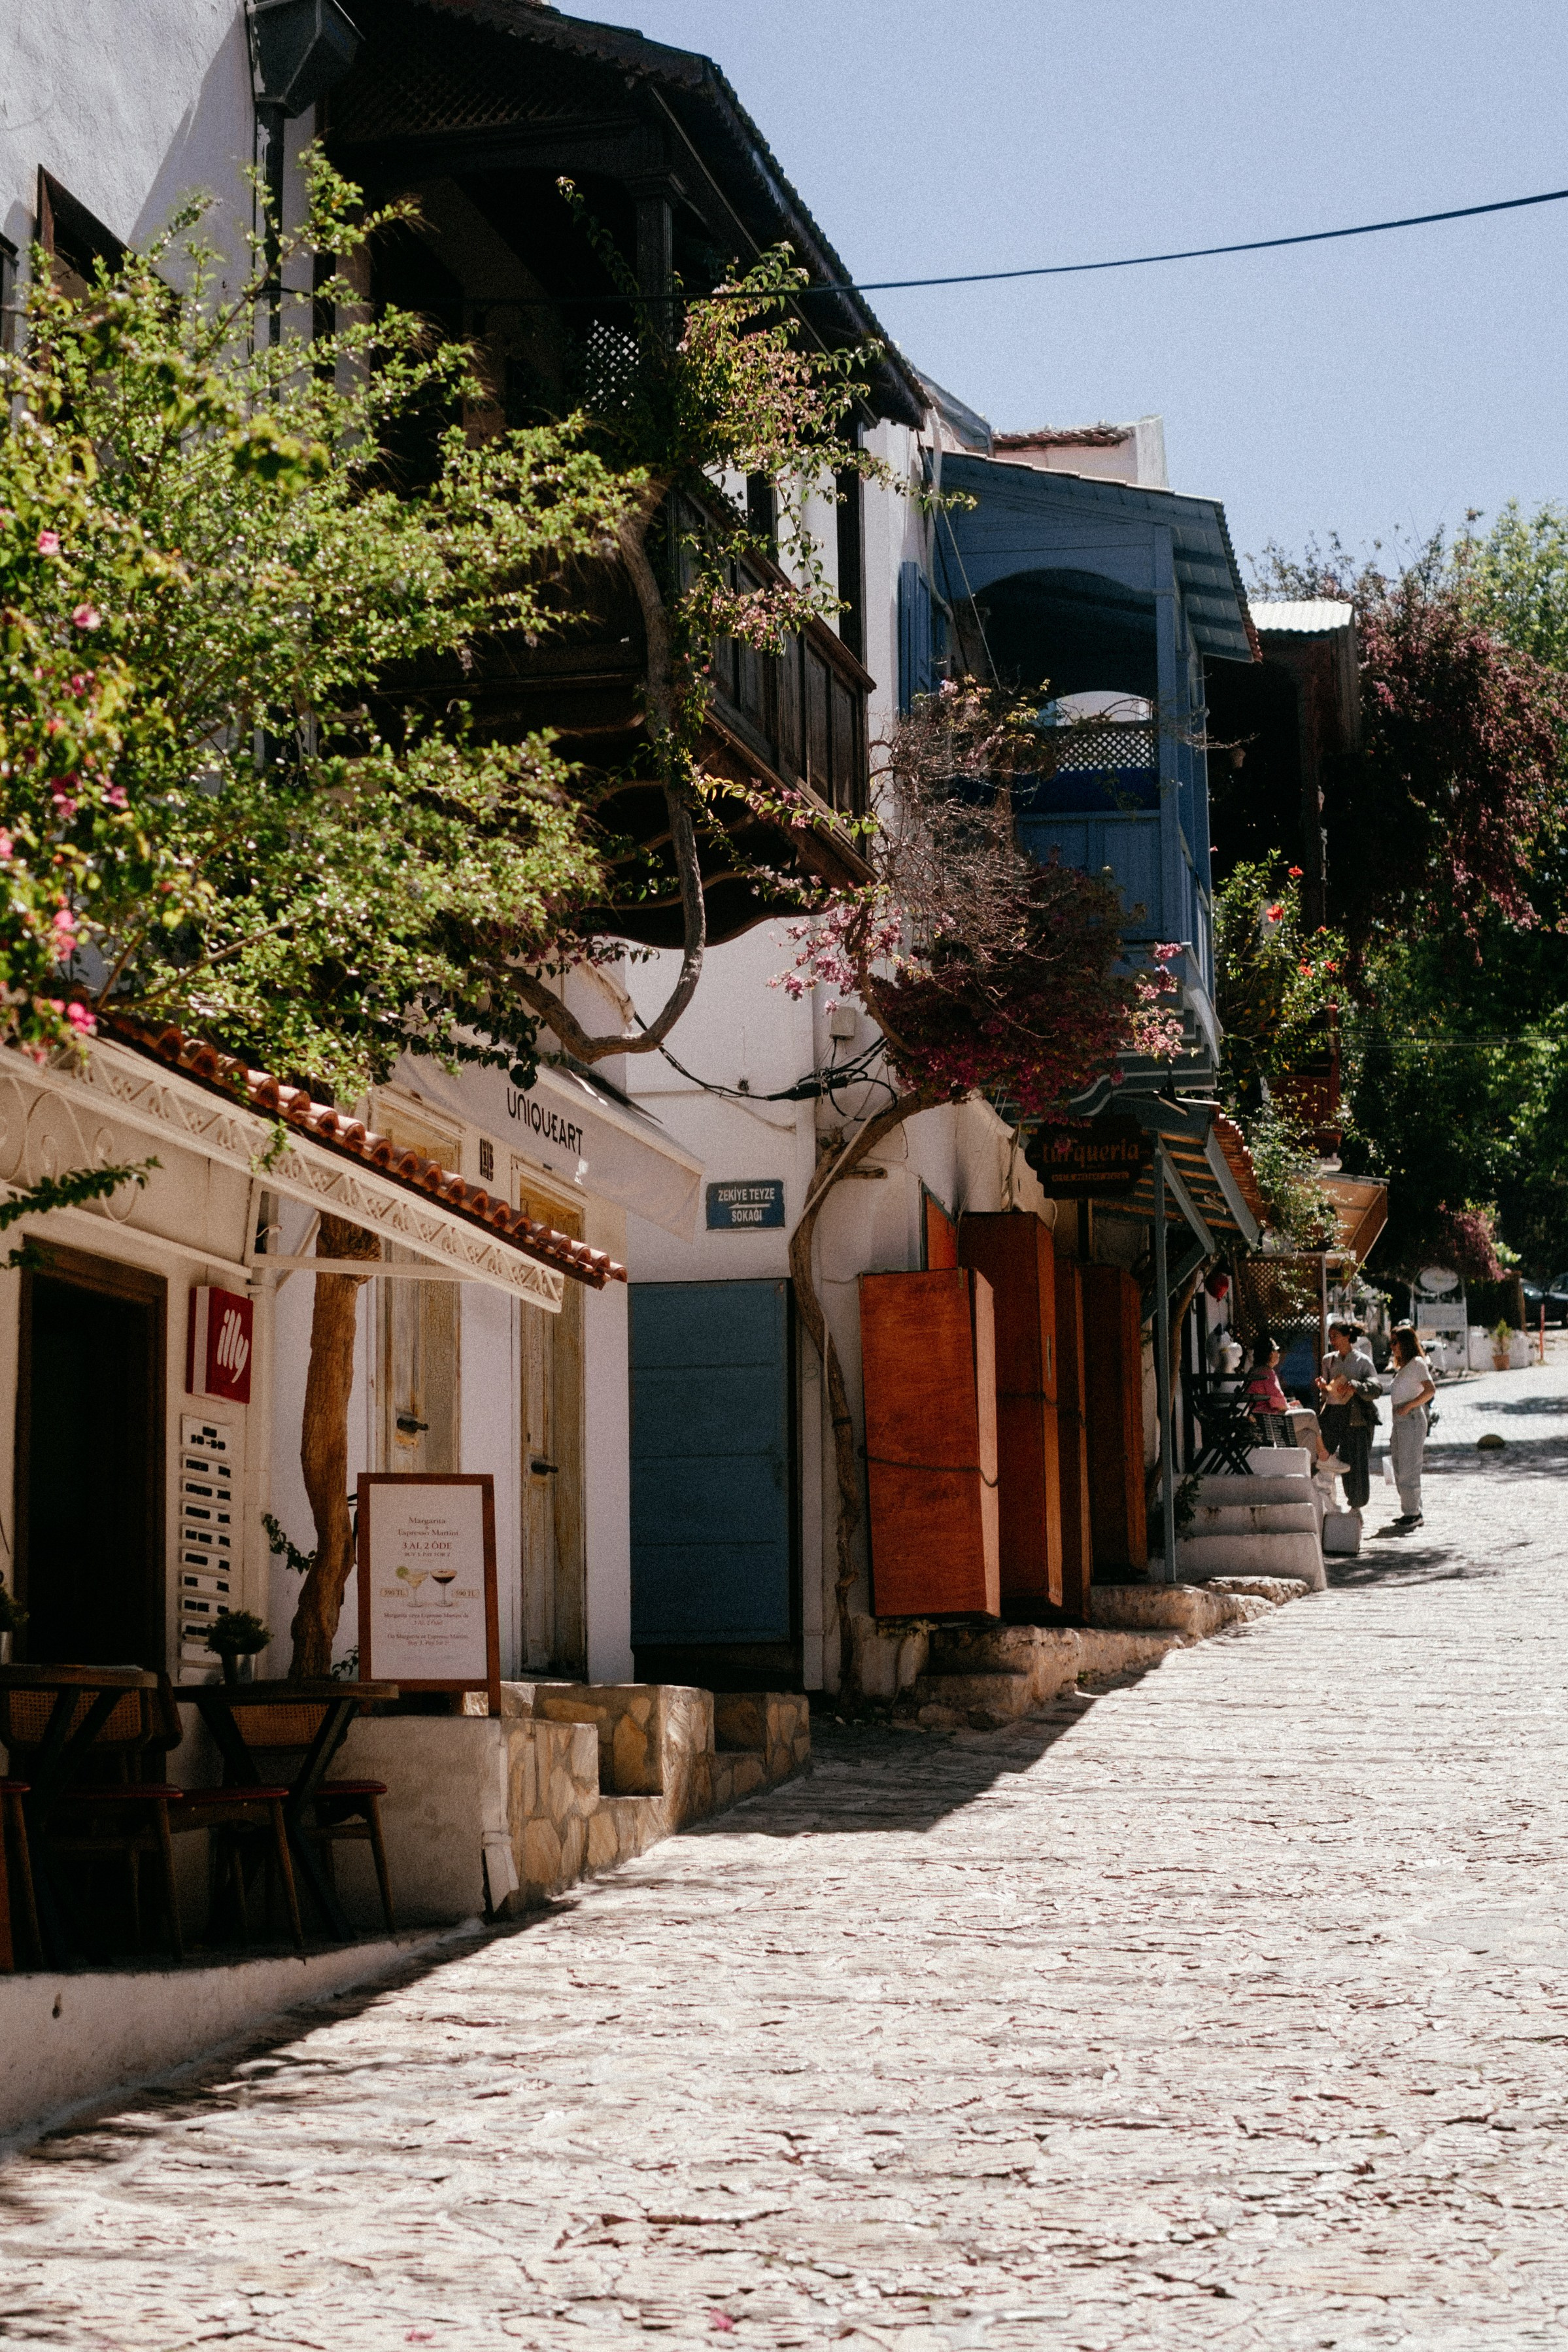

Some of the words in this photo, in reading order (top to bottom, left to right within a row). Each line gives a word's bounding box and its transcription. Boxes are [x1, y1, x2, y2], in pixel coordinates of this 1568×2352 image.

[507, 1087, 583, 1156] UNIQUEART
[717, 1186, 747, 1202] ZEKİYE
[749, 1187, 775, 1201] TEYZE
[731, 1207, 763, 1223] SOKAĞI
[216, 1308, 249, 1384] illy
[409, 1516, 446, 1525] Margarita
[398, 1528, 430, 1537] Espresso
